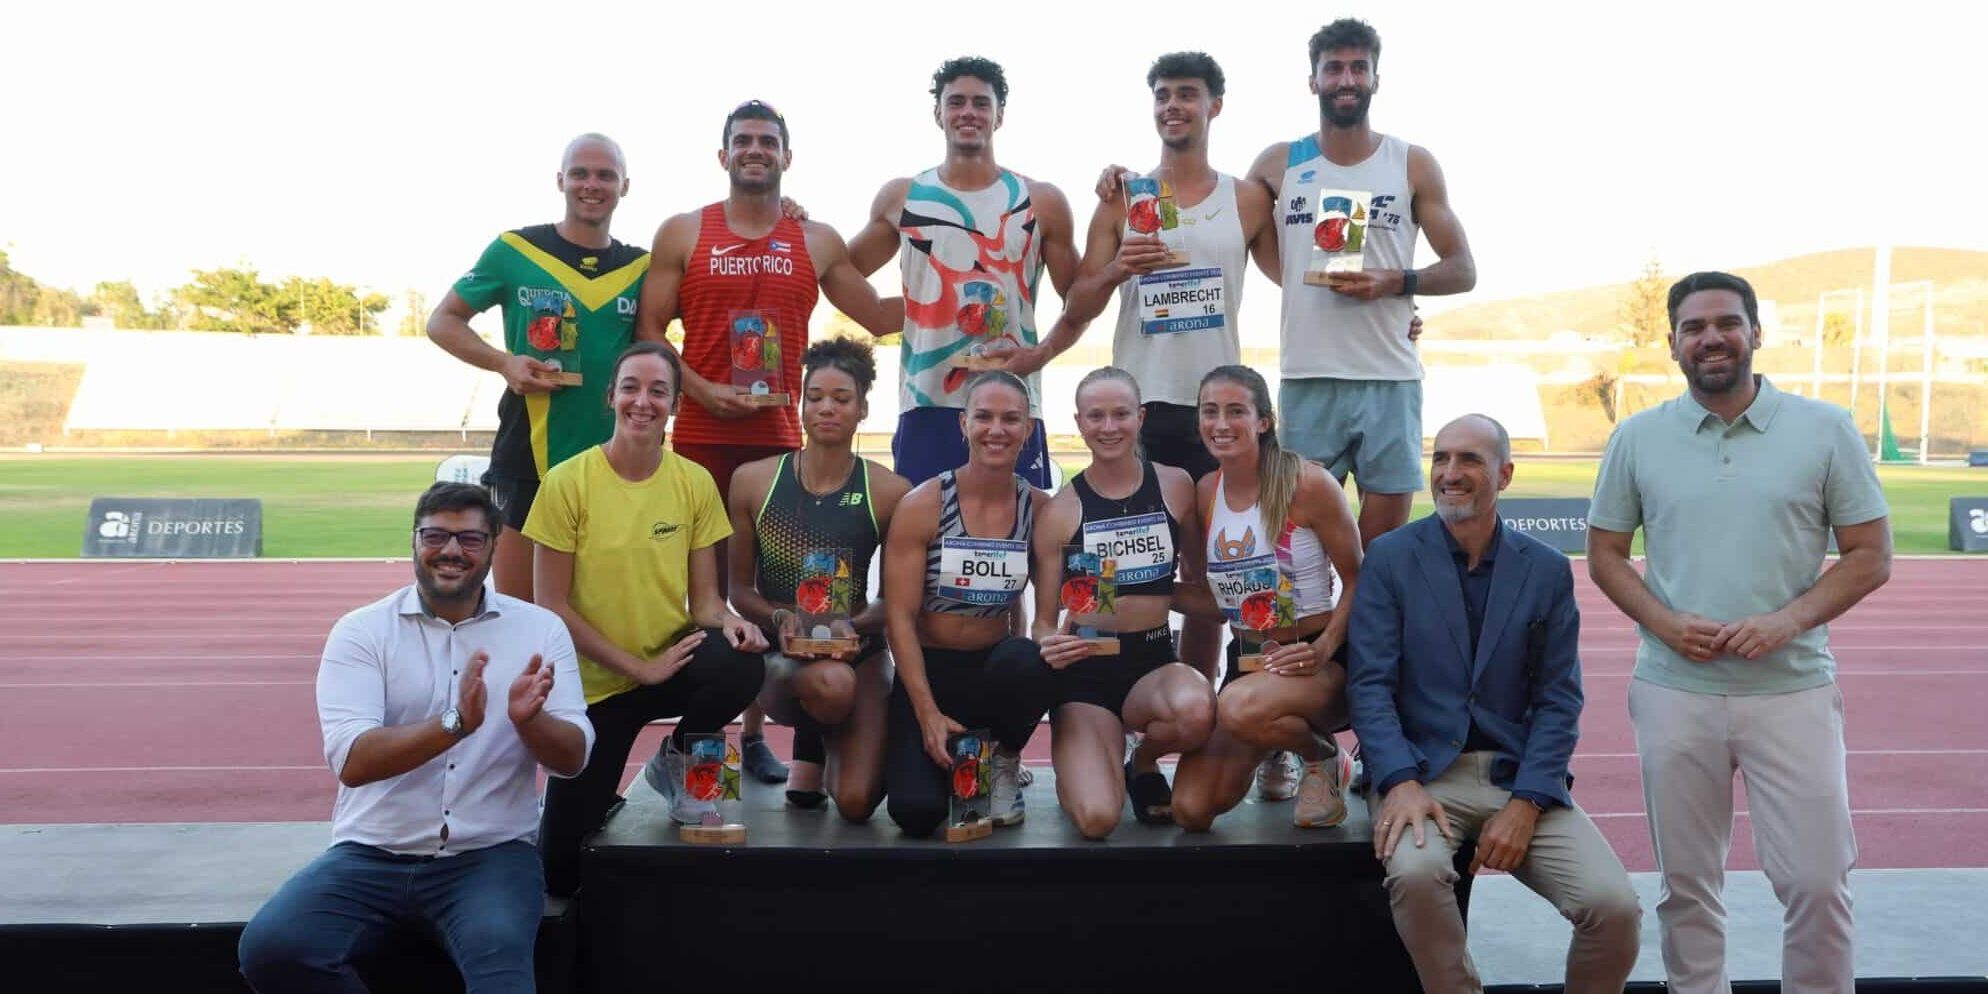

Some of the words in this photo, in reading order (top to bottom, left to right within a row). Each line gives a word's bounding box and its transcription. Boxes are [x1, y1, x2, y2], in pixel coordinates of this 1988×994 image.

[710, 257, 761, 275] PUERTO
[762, 255, 793, 275] RICO
[1144, 288, 1222, 307] LAMBRECHT
[1203, 304, 1216, 315] 16
[148, 520, 245, 535] DEPORTES
[1504, 517, 1587, 531] DEPORTES
[1096, 535, 1166, 558] BICHSEL
[1152, 552, 1165, 564] 25
[962, 560, 1012, 577] BOLL
[1004, 579, 1017, 589] 27
[1145, 628, 1168, 642] NIKE
